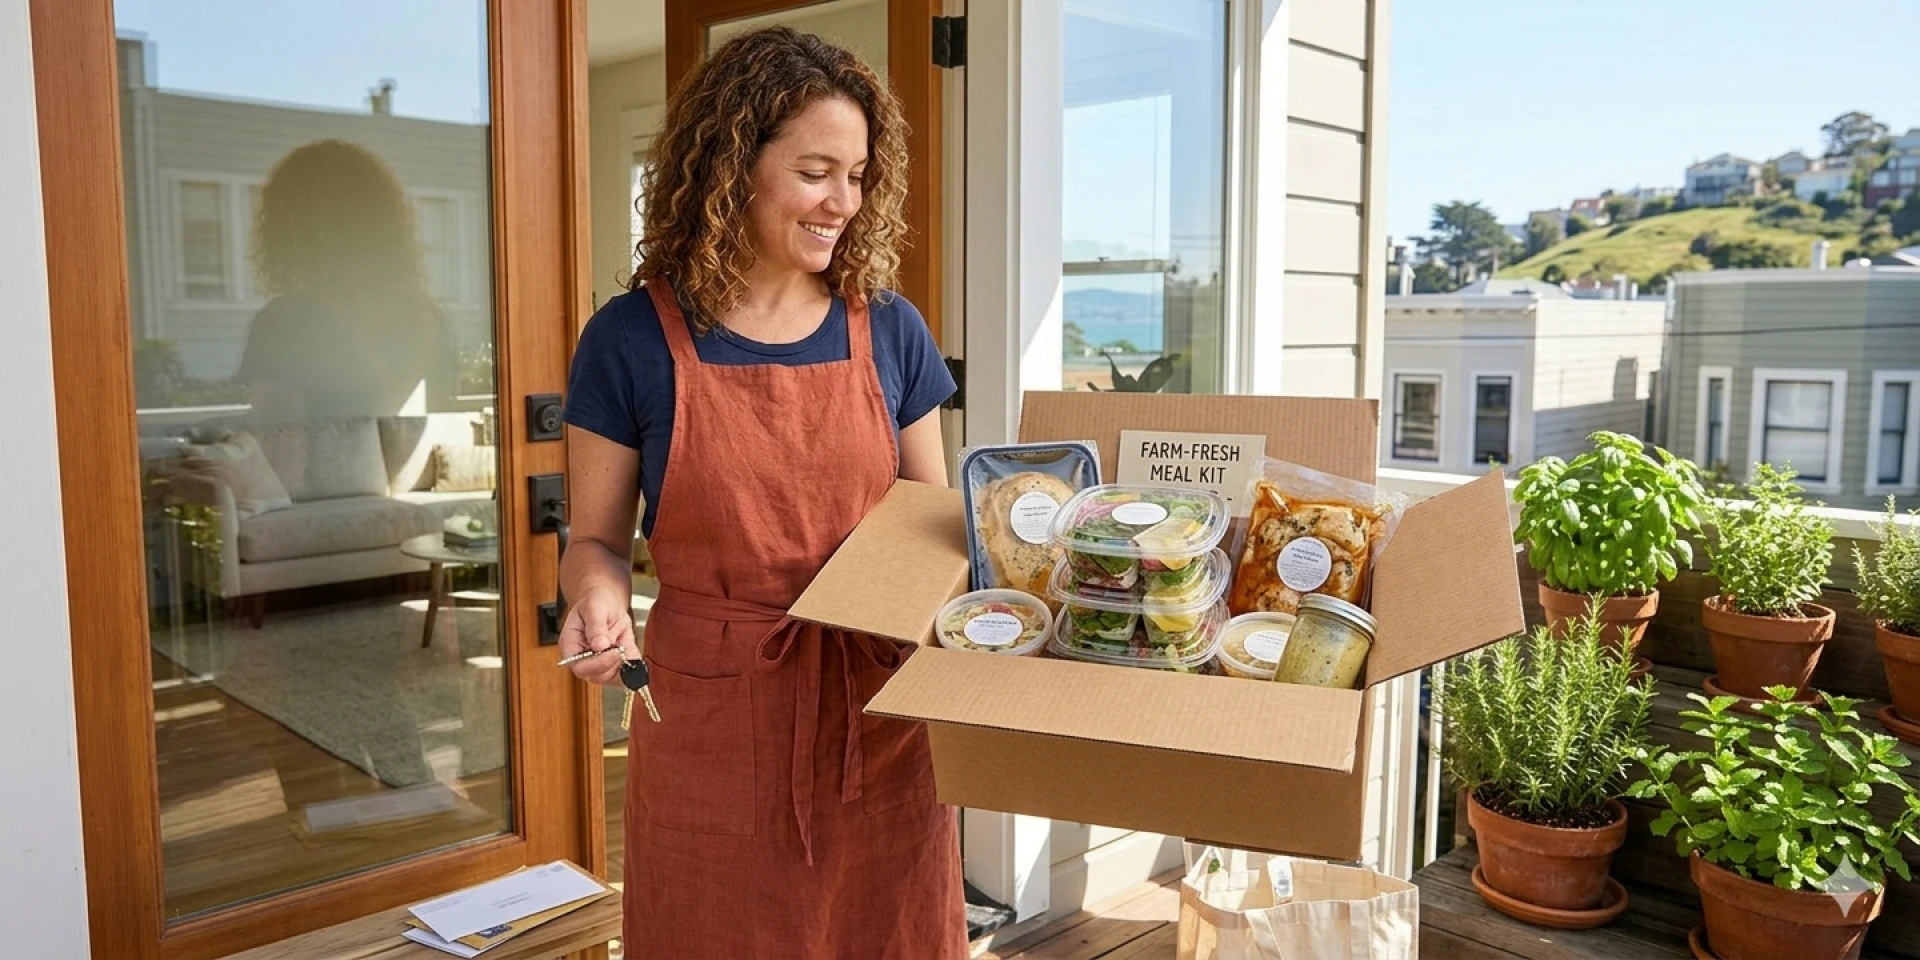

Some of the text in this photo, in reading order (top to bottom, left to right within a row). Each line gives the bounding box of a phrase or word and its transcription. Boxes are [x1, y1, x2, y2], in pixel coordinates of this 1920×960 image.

[1140, 441, 1240, 462] FARM-FRESH
[1149, 464, 1227, 485] MEAL KIT
